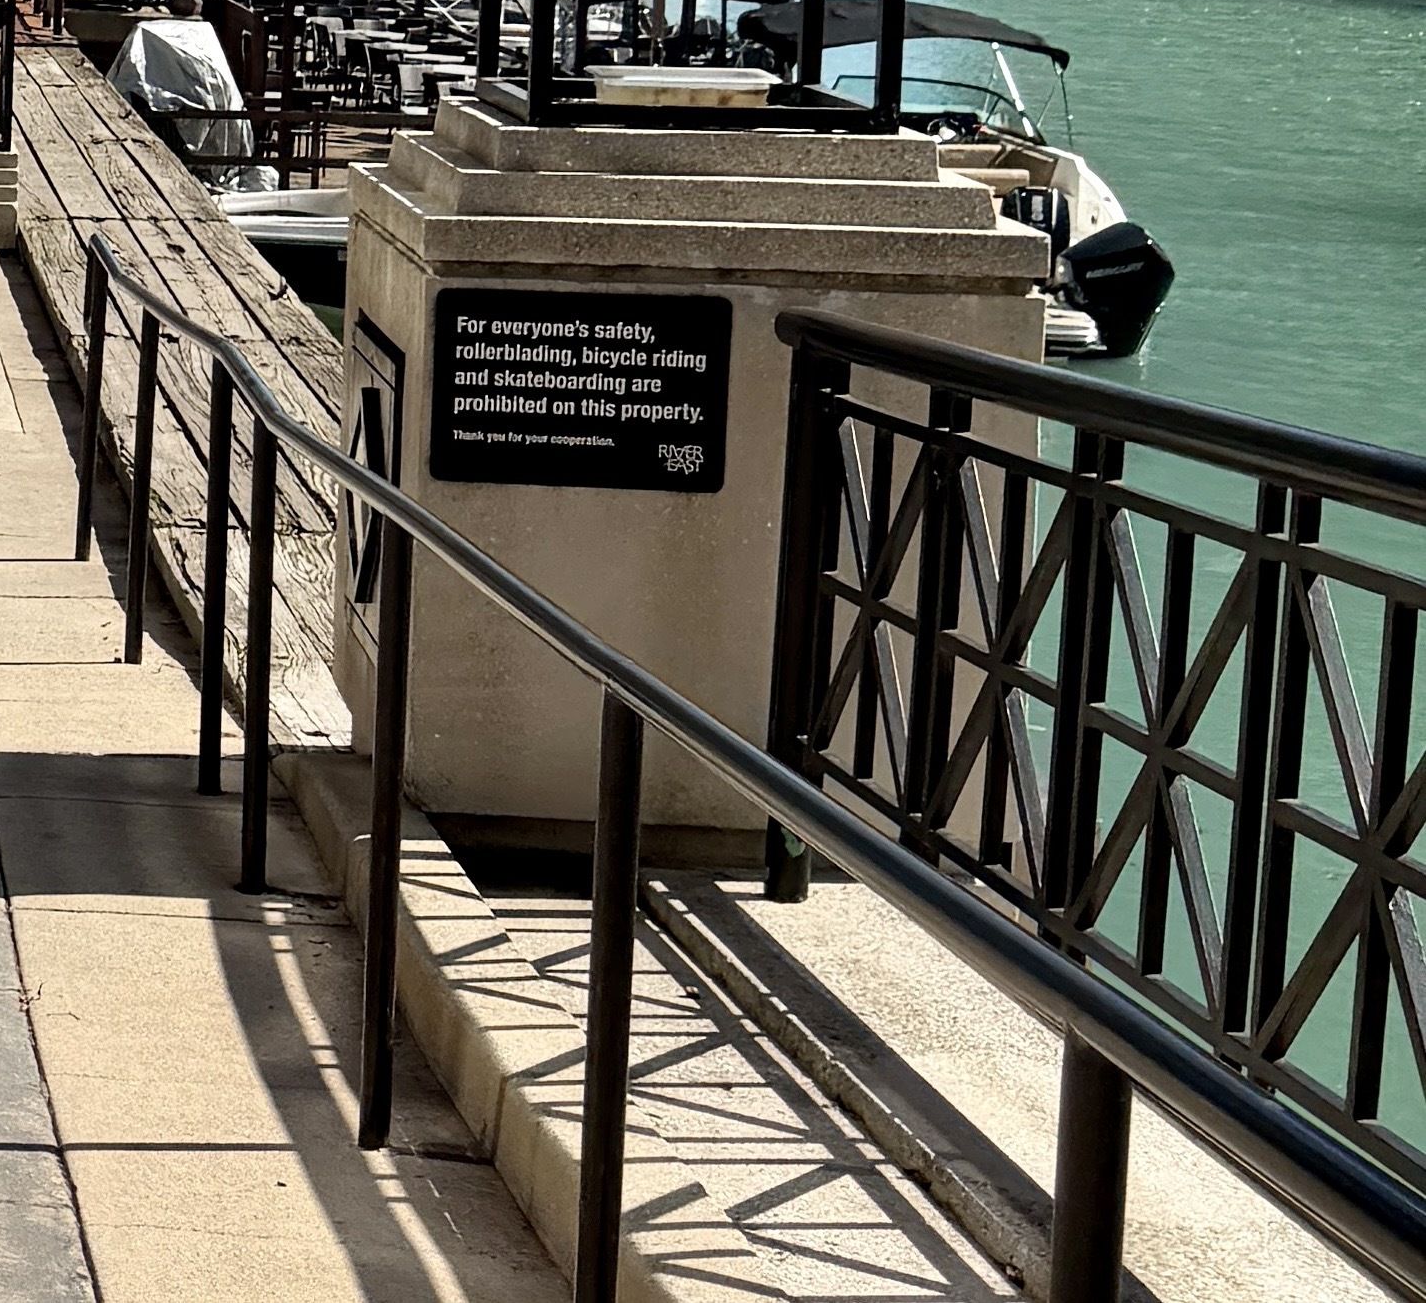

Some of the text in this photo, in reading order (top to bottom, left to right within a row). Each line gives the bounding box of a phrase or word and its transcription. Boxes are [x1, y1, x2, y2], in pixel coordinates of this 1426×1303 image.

[456, 315, 656, 344] For everyone's safety,
[455, 342, 707, 373] rollerblading, bicycle riding
[454, 368, 662, 395] and skateboarding are
[453, 394, 704, 425] prohibited on this property.
[453, 429, 616, 447] Thank you for your cooperation.
[658, 444, 704, 463] RIVER
[664, 457, 700, 475] EAST
